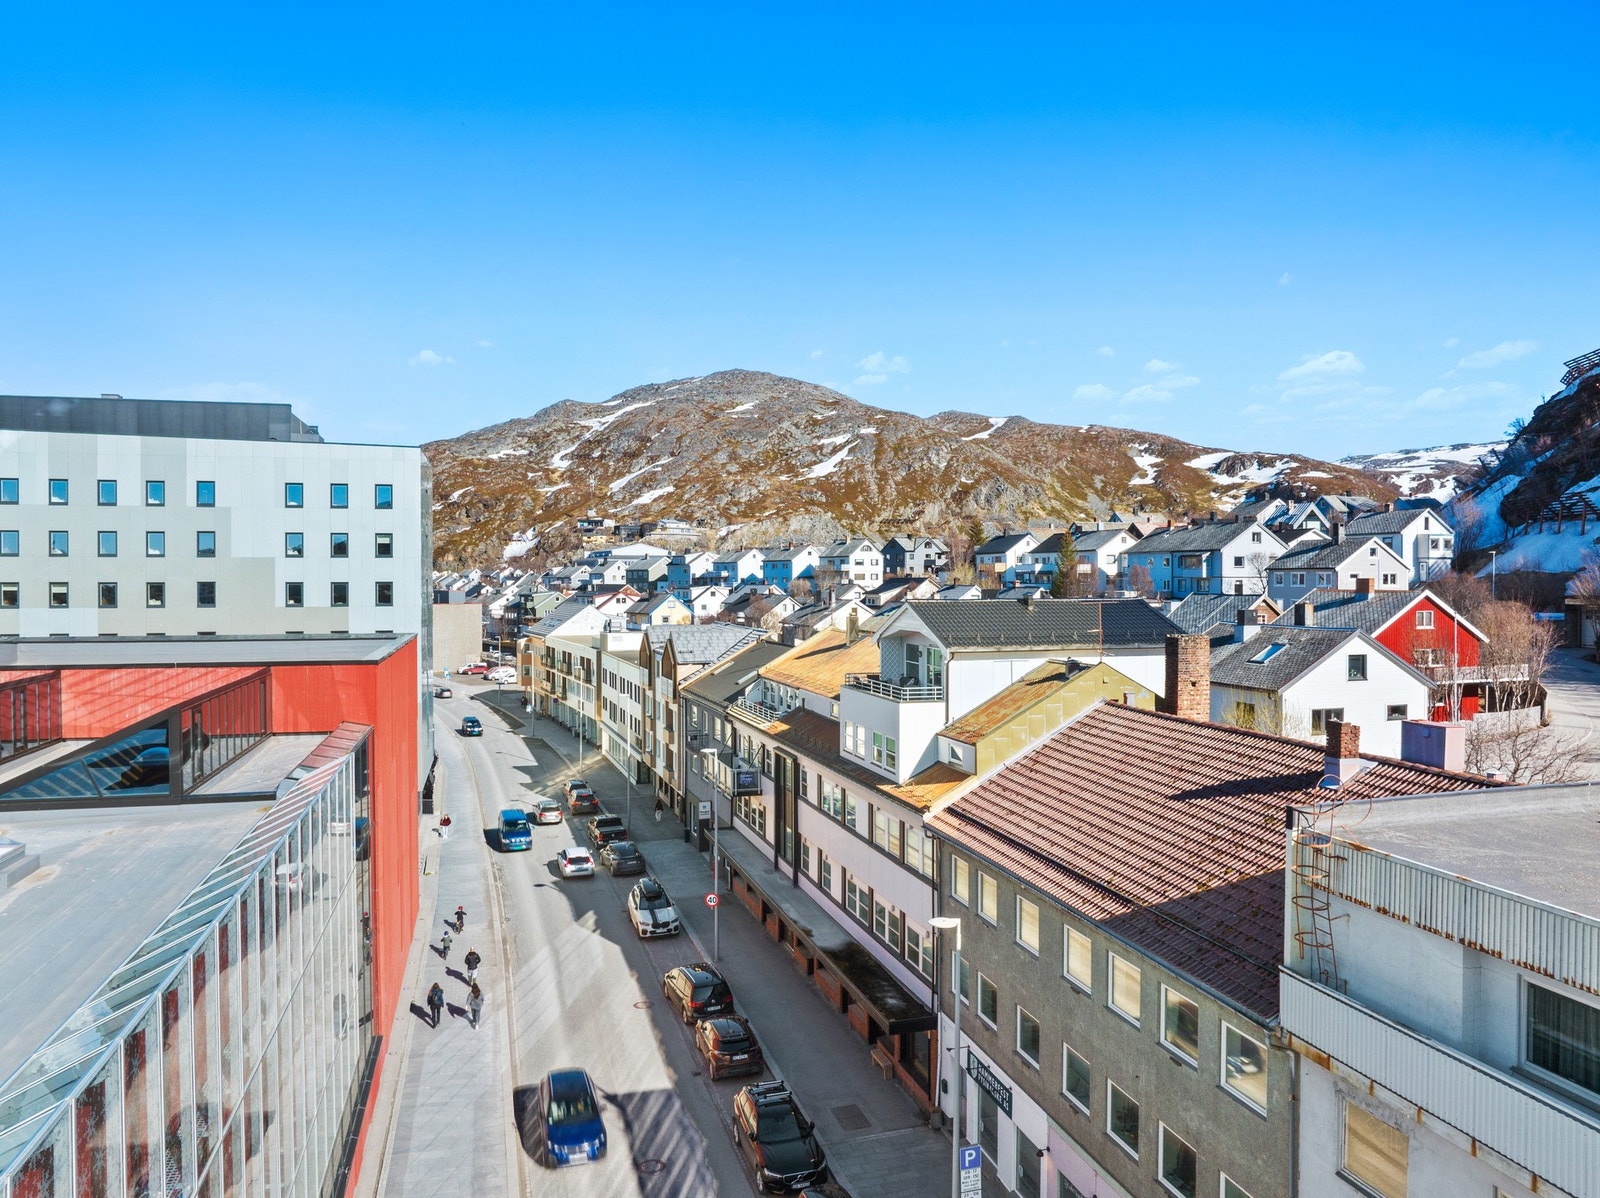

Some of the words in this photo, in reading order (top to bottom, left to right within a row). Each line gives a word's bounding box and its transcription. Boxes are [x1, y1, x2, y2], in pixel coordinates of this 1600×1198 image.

[708, 896, 717, 904] 40
[978, 1063, 1009, 1102] HAMMERFEST
[965, 1150, 976, 1167] P
